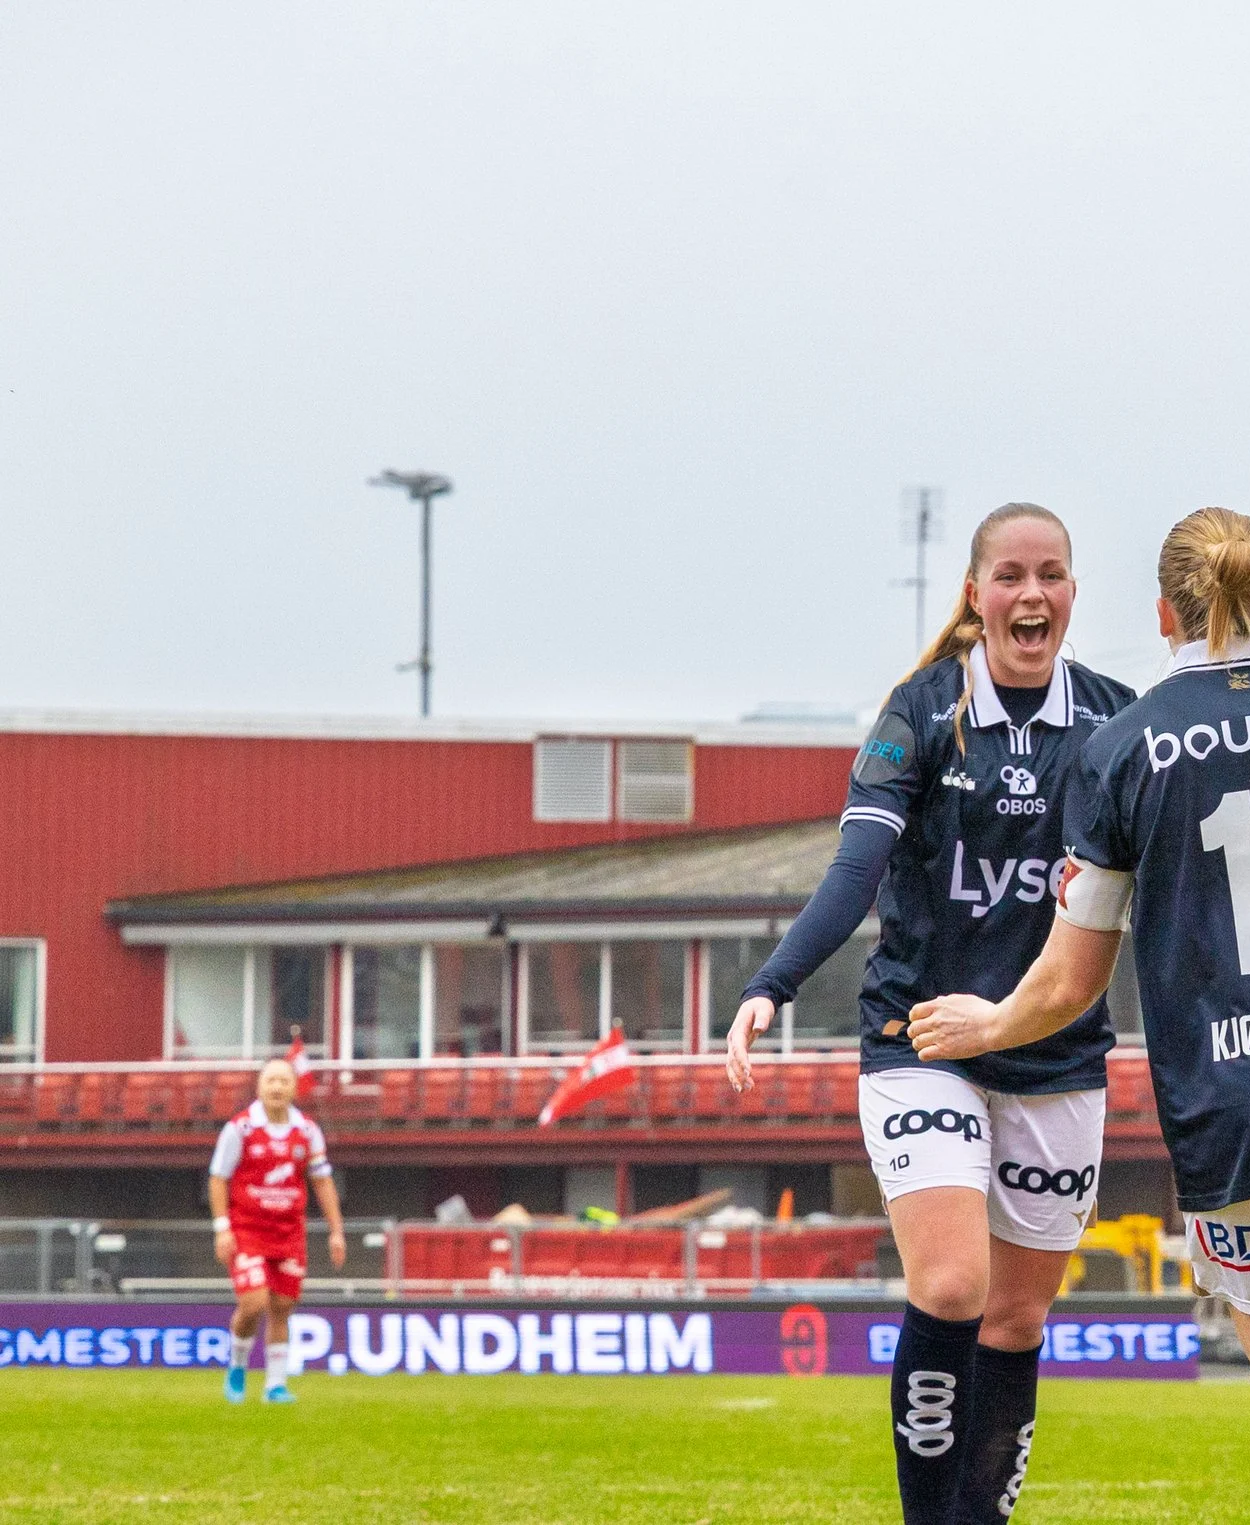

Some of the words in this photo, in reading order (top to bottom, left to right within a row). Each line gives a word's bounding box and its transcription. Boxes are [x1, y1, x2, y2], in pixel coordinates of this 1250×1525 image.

[996, 798, 1047, 815] OBOS
[884, 1108, 982, 1142] coop
[889, 1153, 910, 1172] 10
[998, 1161, 1095, 1201] coop
[287, 1313, 714, 1376] P.UNDHEIM
